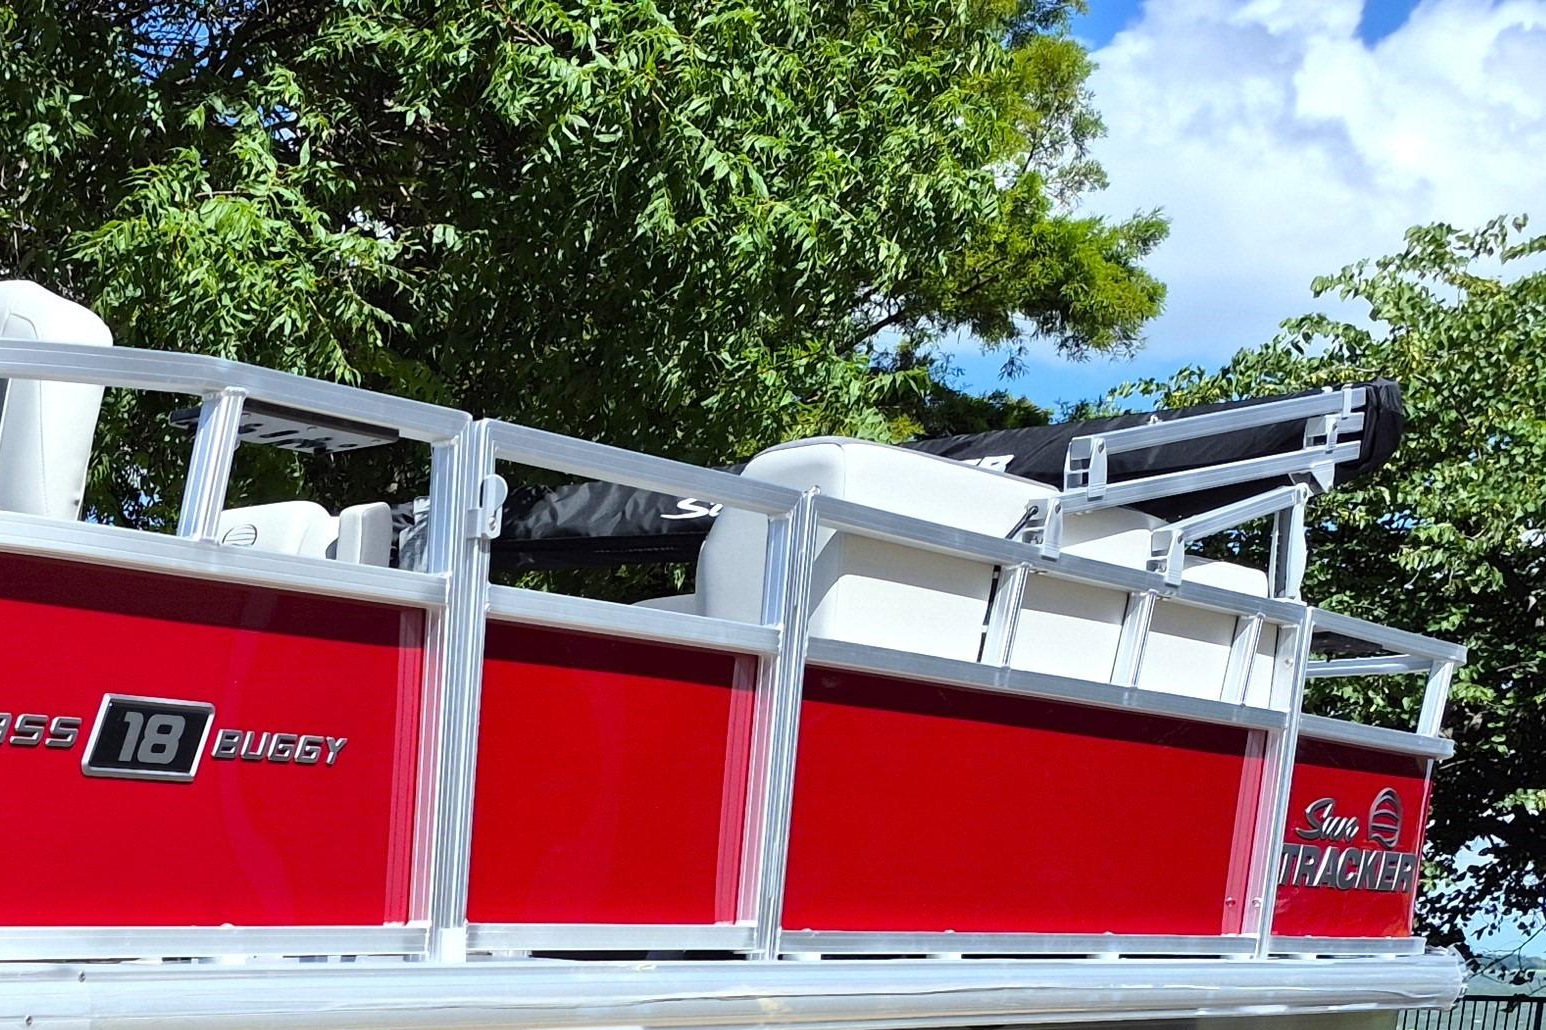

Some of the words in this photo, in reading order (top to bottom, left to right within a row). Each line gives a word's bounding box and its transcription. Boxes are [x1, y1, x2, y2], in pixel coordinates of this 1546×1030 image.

[118, 711, 187, 765] 18
[211, 729, 347, 765] BUGGY
[1295, 797, 1360, 842] Sun
[1278, 843, 1417, 892] TRACKER
